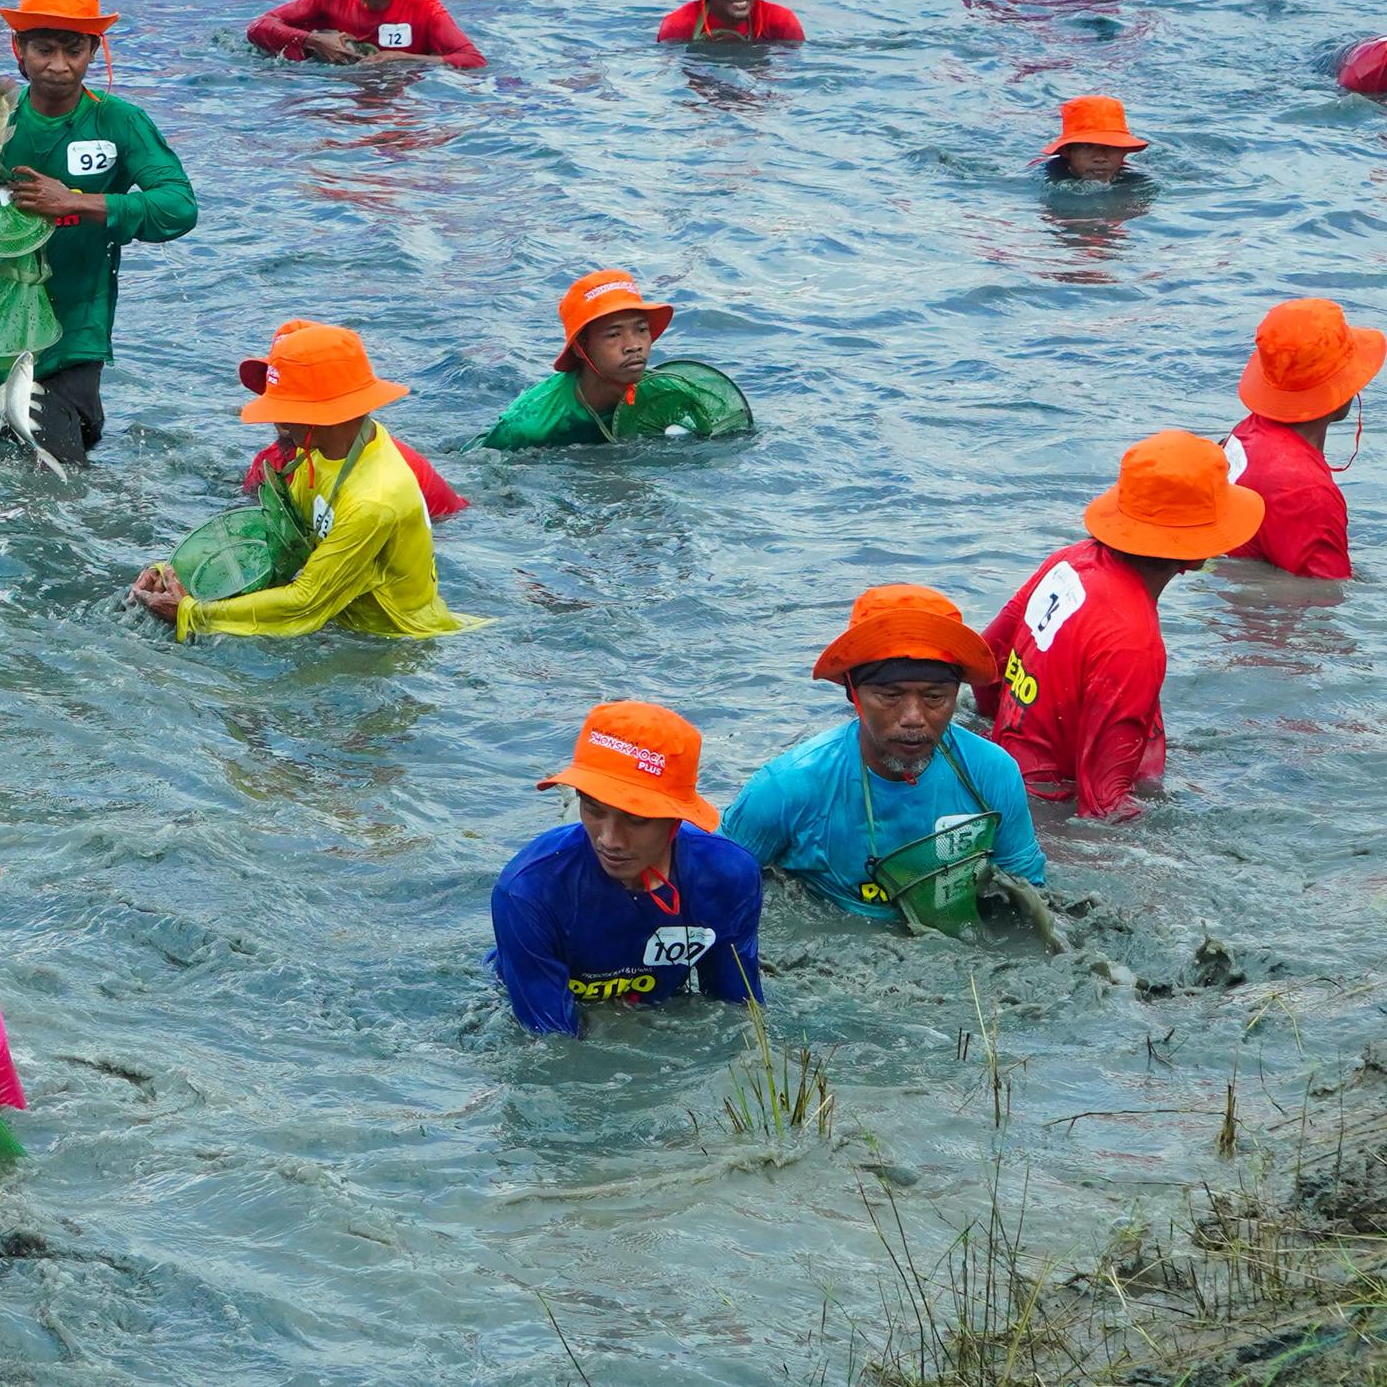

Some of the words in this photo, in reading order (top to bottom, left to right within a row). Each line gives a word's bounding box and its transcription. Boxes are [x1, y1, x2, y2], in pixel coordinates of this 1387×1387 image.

[387, 32, 403, 46] 12
[79, 153, 108, 171] 92
[638, 761, 662, 776] PLUS
[567, 975, 657, 1000] PETRO
